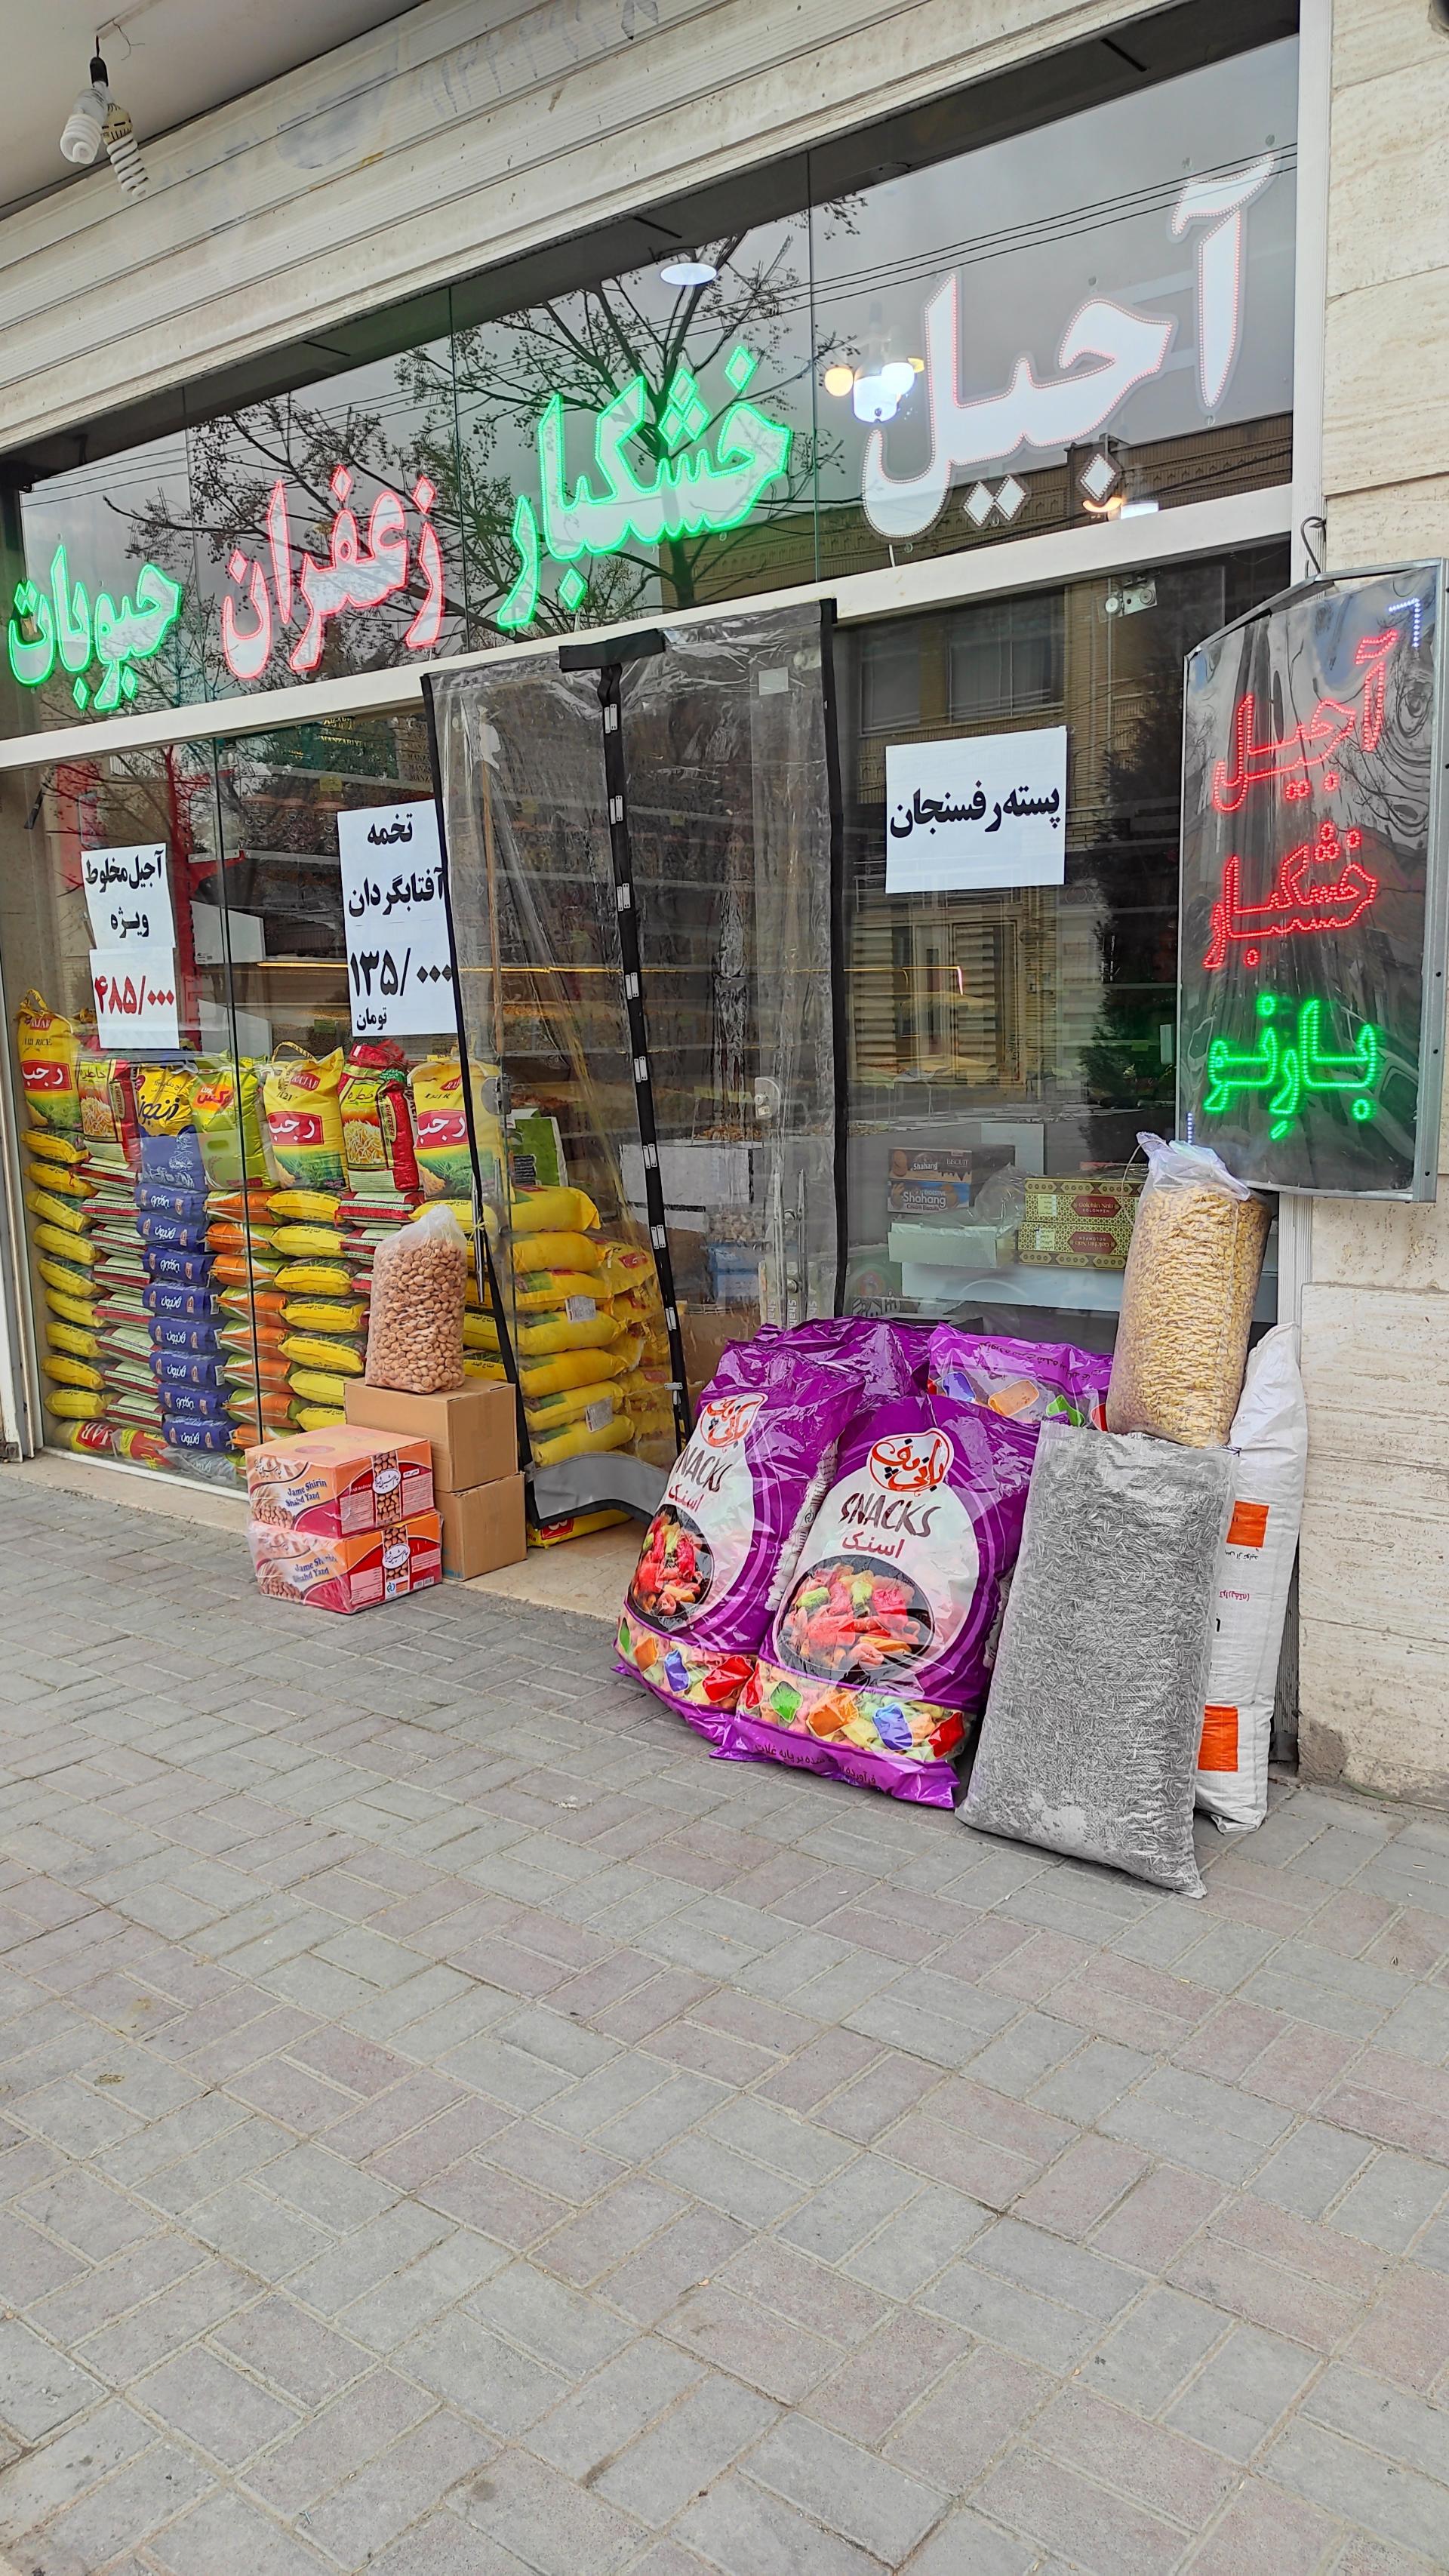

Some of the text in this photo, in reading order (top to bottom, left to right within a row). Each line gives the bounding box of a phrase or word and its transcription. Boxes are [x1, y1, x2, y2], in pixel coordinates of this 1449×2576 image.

[862, 152, 1275, 538] آجیل
[496, 344, 792, 629] خشکبار
[222, 465, 445, 680] زعفران
[8, 545, 183, 711] حبوبات
[1213, 629, 1398, 812] آجیل
[890, 780, 1060, 839] پسته رفسنجان
[367, 813, 413, 845] تخمه
[85, 849, 164, 893] آجیل مخلوط
[349, 866, 444, 917] آفتابگردان
[1203, 821, 1378, 968] خشکبار
[110, 906, 149, 938] ویژه
[356, 1006, 388, 1030] تومان
[386, 1103, 395, 1137] KHATEREH
[913, 1162, 938, 1171] Shahang
[903, 1192, 946, 1208] Shahang
[288, 1479, 328, 1497] Jame Shirin
[304, 1492, 320, 1503] Yazd
[838, 1492, 943, 1537] SNACKS
[841, 1531, 906, 1559] اسنک
[312, 1568, 330, 1578] Yazd
[755, 1744, 777, 1756] غلات
[779, 1750, 795, 1762] پایه
